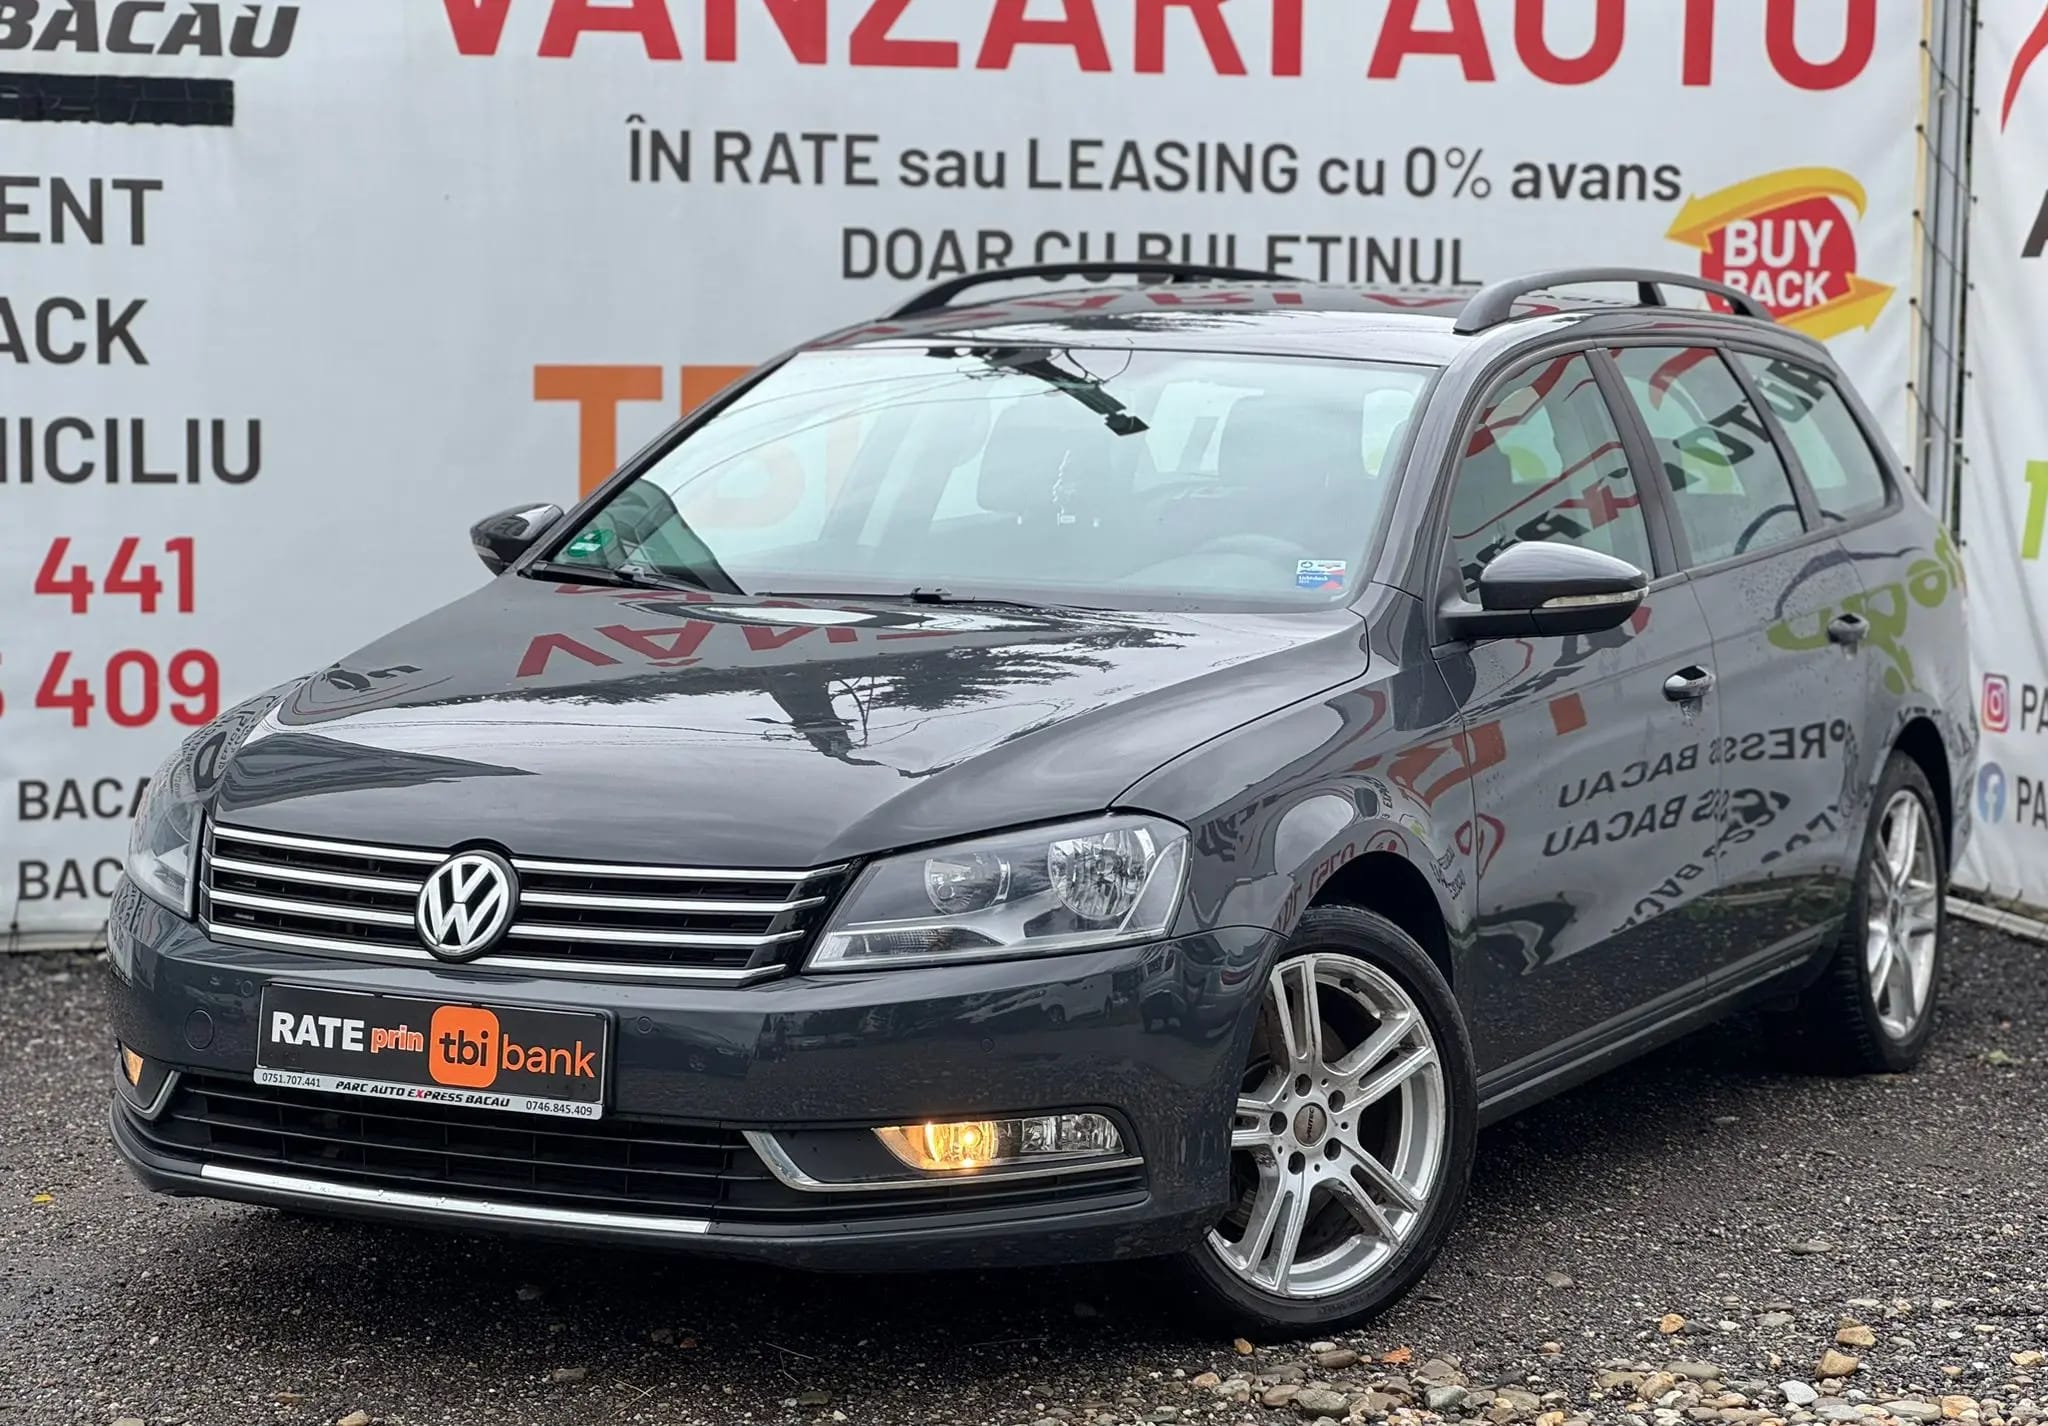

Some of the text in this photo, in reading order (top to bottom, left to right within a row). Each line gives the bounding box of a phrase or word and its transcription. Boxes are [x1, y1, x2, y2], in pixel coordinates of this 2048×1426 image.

[626, 114, 1682, 202] ÎN RATE sau LEASING cu 0% avans
[842, 227, 1014, 281] DOAR
[1034, 230, 1116, 283] CU
[1723, 218, 1834, 269] BUY
[1722, 270, 1832, 308] BACK
[0, 416, 262, 485] ICILIU
[34, 536, 196, 614] 441
[34, 648, 220, 729] 409
[270, 1010, 597, 1079] RATE prin tbi bank
[262, 1072, 593, 1117] 0751.707.441 PARC AUTO EXPRESS BACAU 0746.845.409
